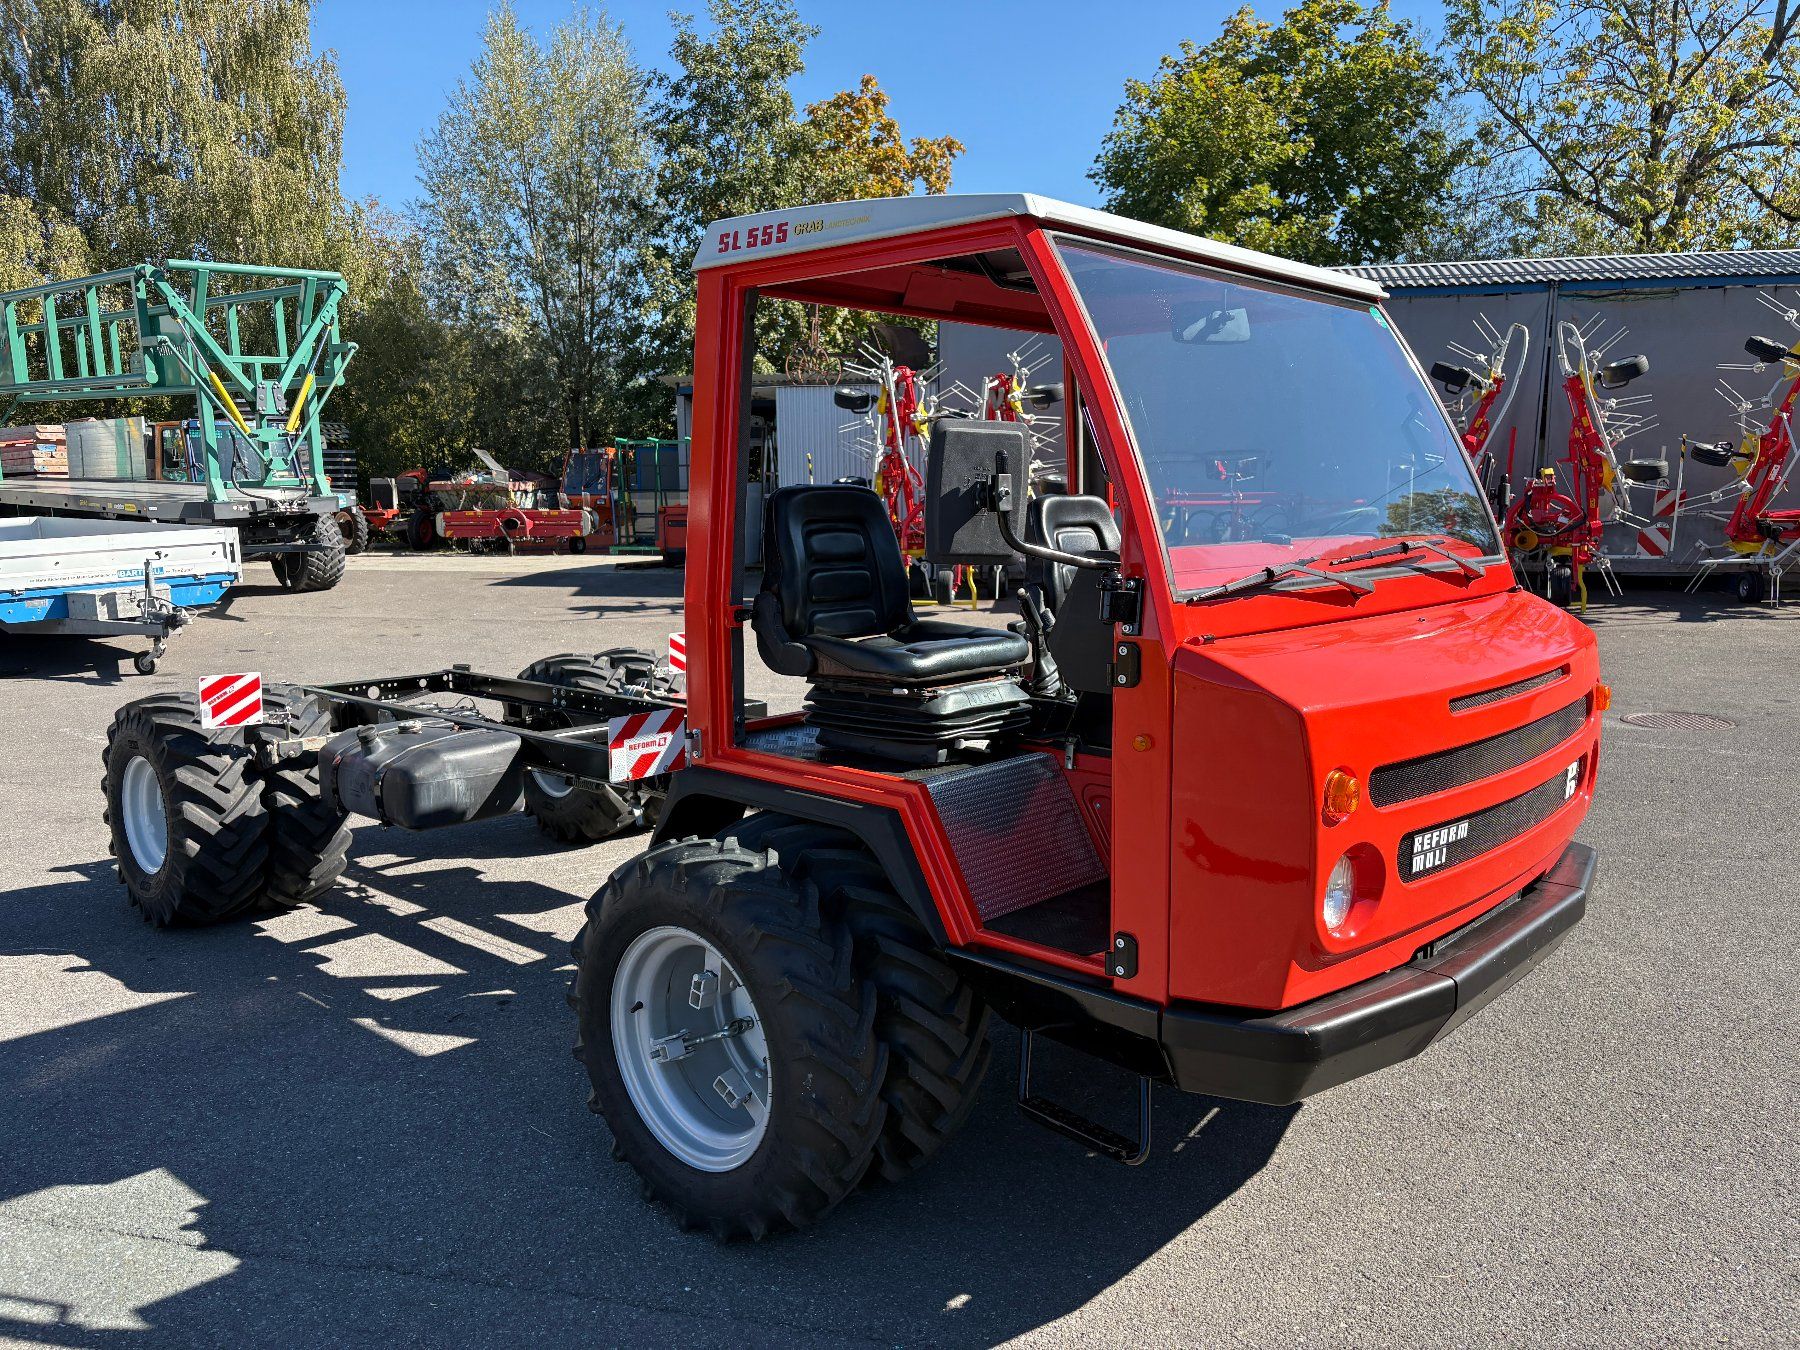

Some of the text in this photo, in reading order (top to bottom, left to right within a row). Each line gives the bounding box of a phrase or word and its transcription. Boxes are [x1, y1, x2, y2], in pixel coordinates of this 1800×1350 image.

[717, 222, 789, 254] SL 555
[119, 568, 161, 577] BARTU
[628, 740, 657, 751] REFORM
[1413, 821, 1469, 854] REFORM
